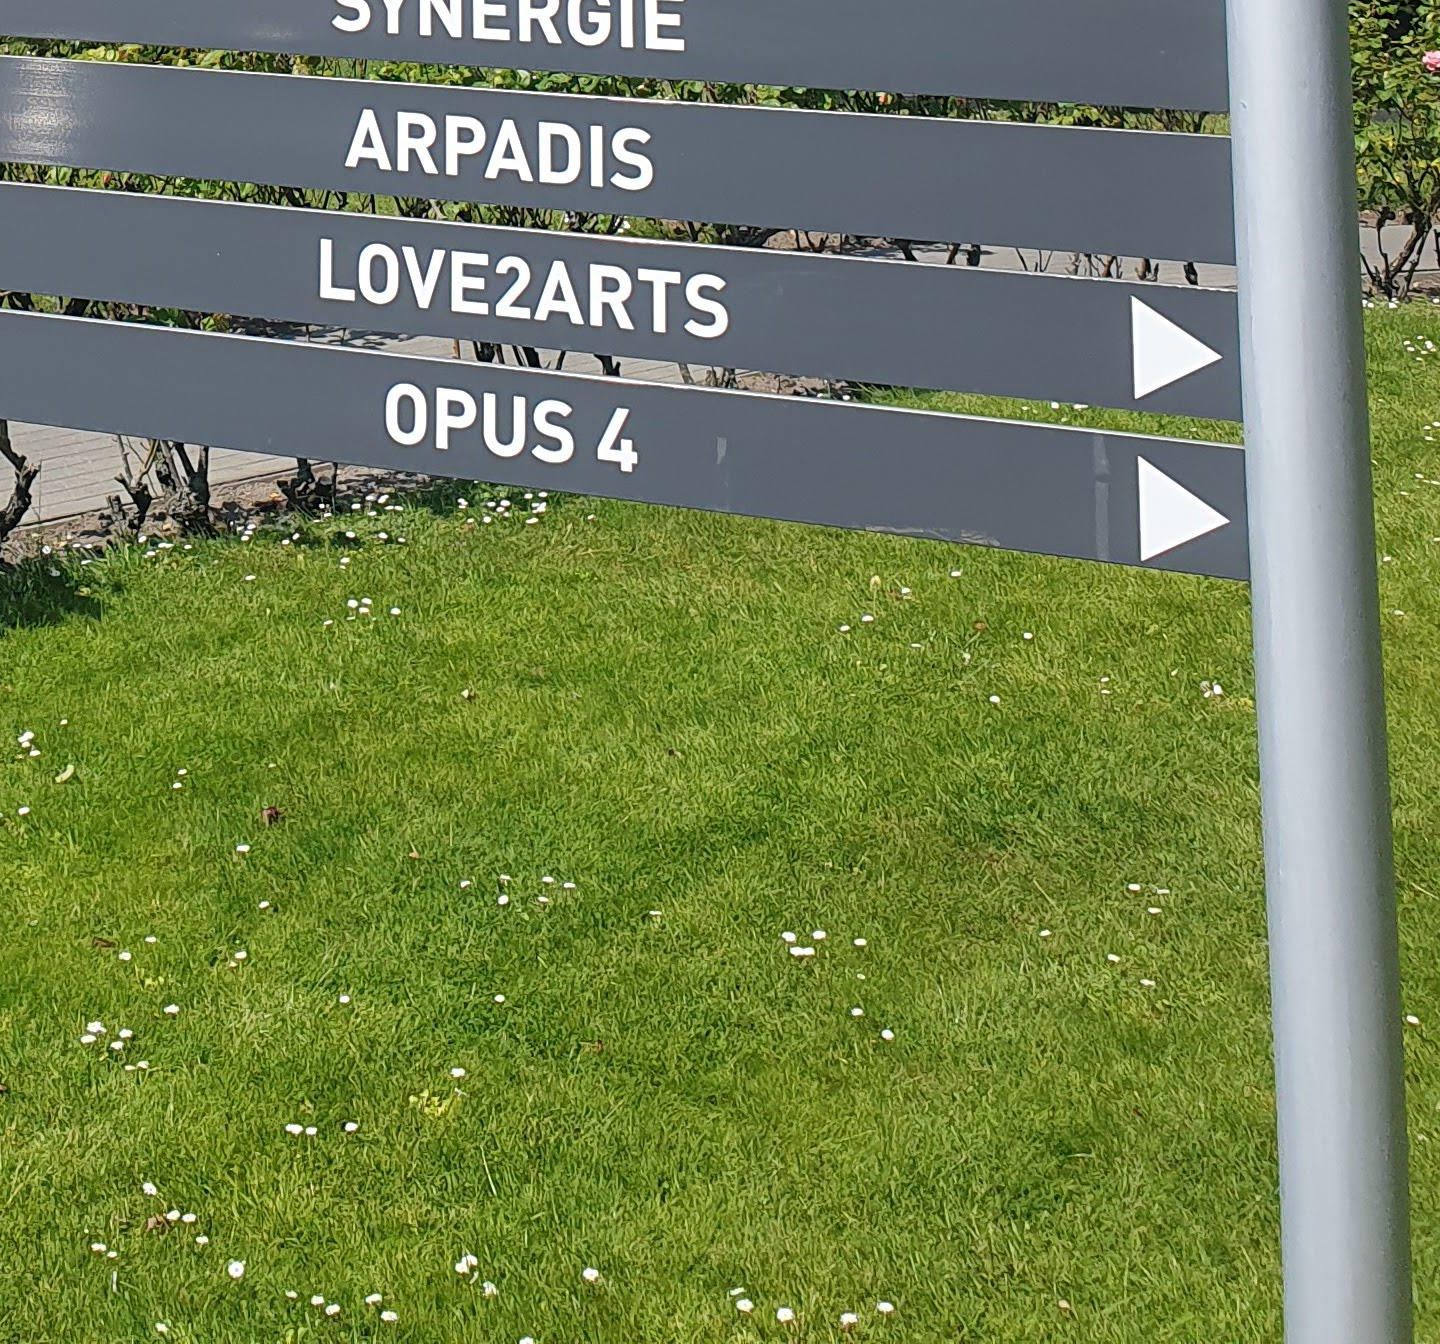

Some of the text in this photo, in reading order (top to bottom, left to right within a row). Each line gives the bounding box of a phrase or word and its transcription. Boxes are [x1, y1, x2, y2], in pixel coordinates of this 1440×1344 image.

[344, 108, 654, 192] ARPADIS
[318, 238, 730, 339] LOVE2ARTS
[385, 383, 639, 474] OPUS 4
